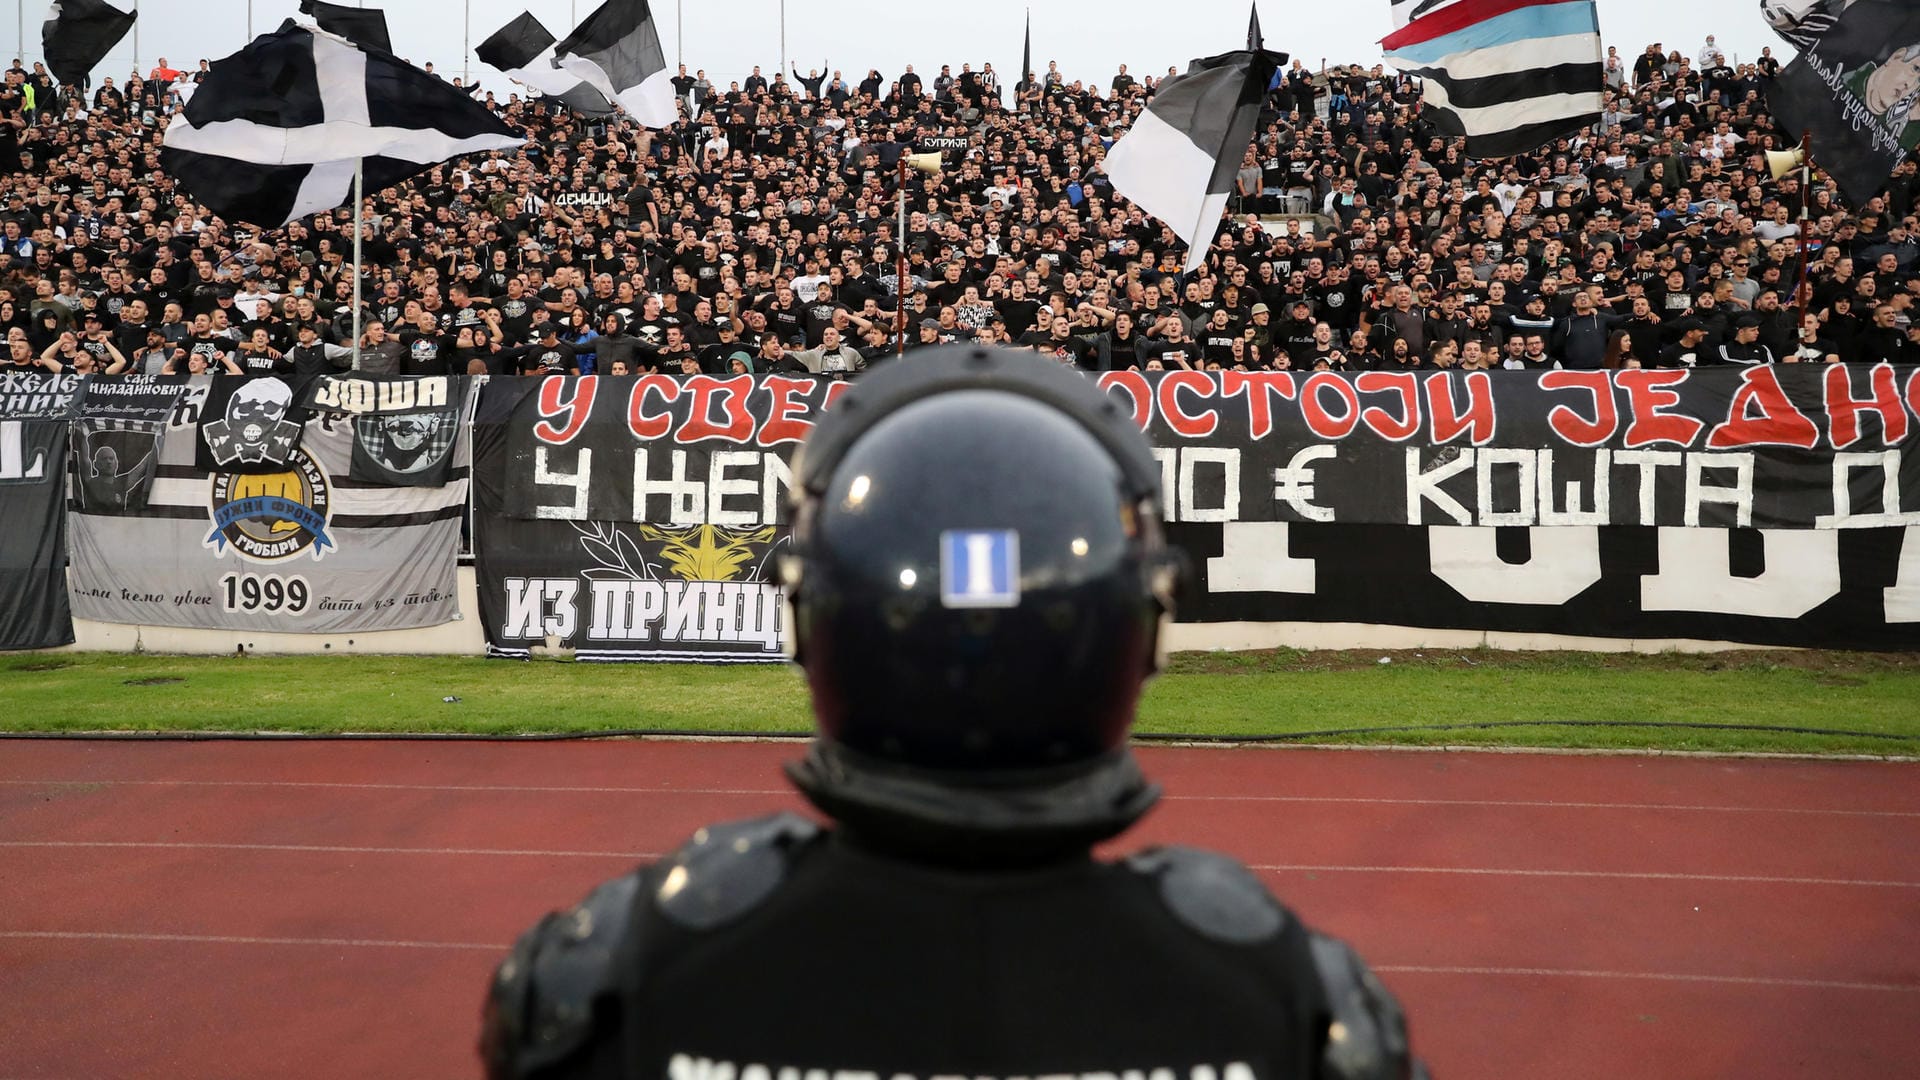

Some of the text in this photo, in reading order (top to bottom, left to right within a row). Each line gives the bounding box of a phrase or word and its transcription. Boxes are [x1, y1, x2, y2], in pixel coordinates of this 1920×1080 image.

[532, 374, 599, 446] У
[628, 374, 848, 446] СВЕ
[1095, 370, 1497, 447] ОСТОЈИ
[535, 446, 592, 521] У
[1405, 446, 1755, 528] КОШТА
[235, 535, 300, 557] ГРОБАРИ
[221, 575, 311, 613] 1999
[504, 578, 579, 641] ИЗ
